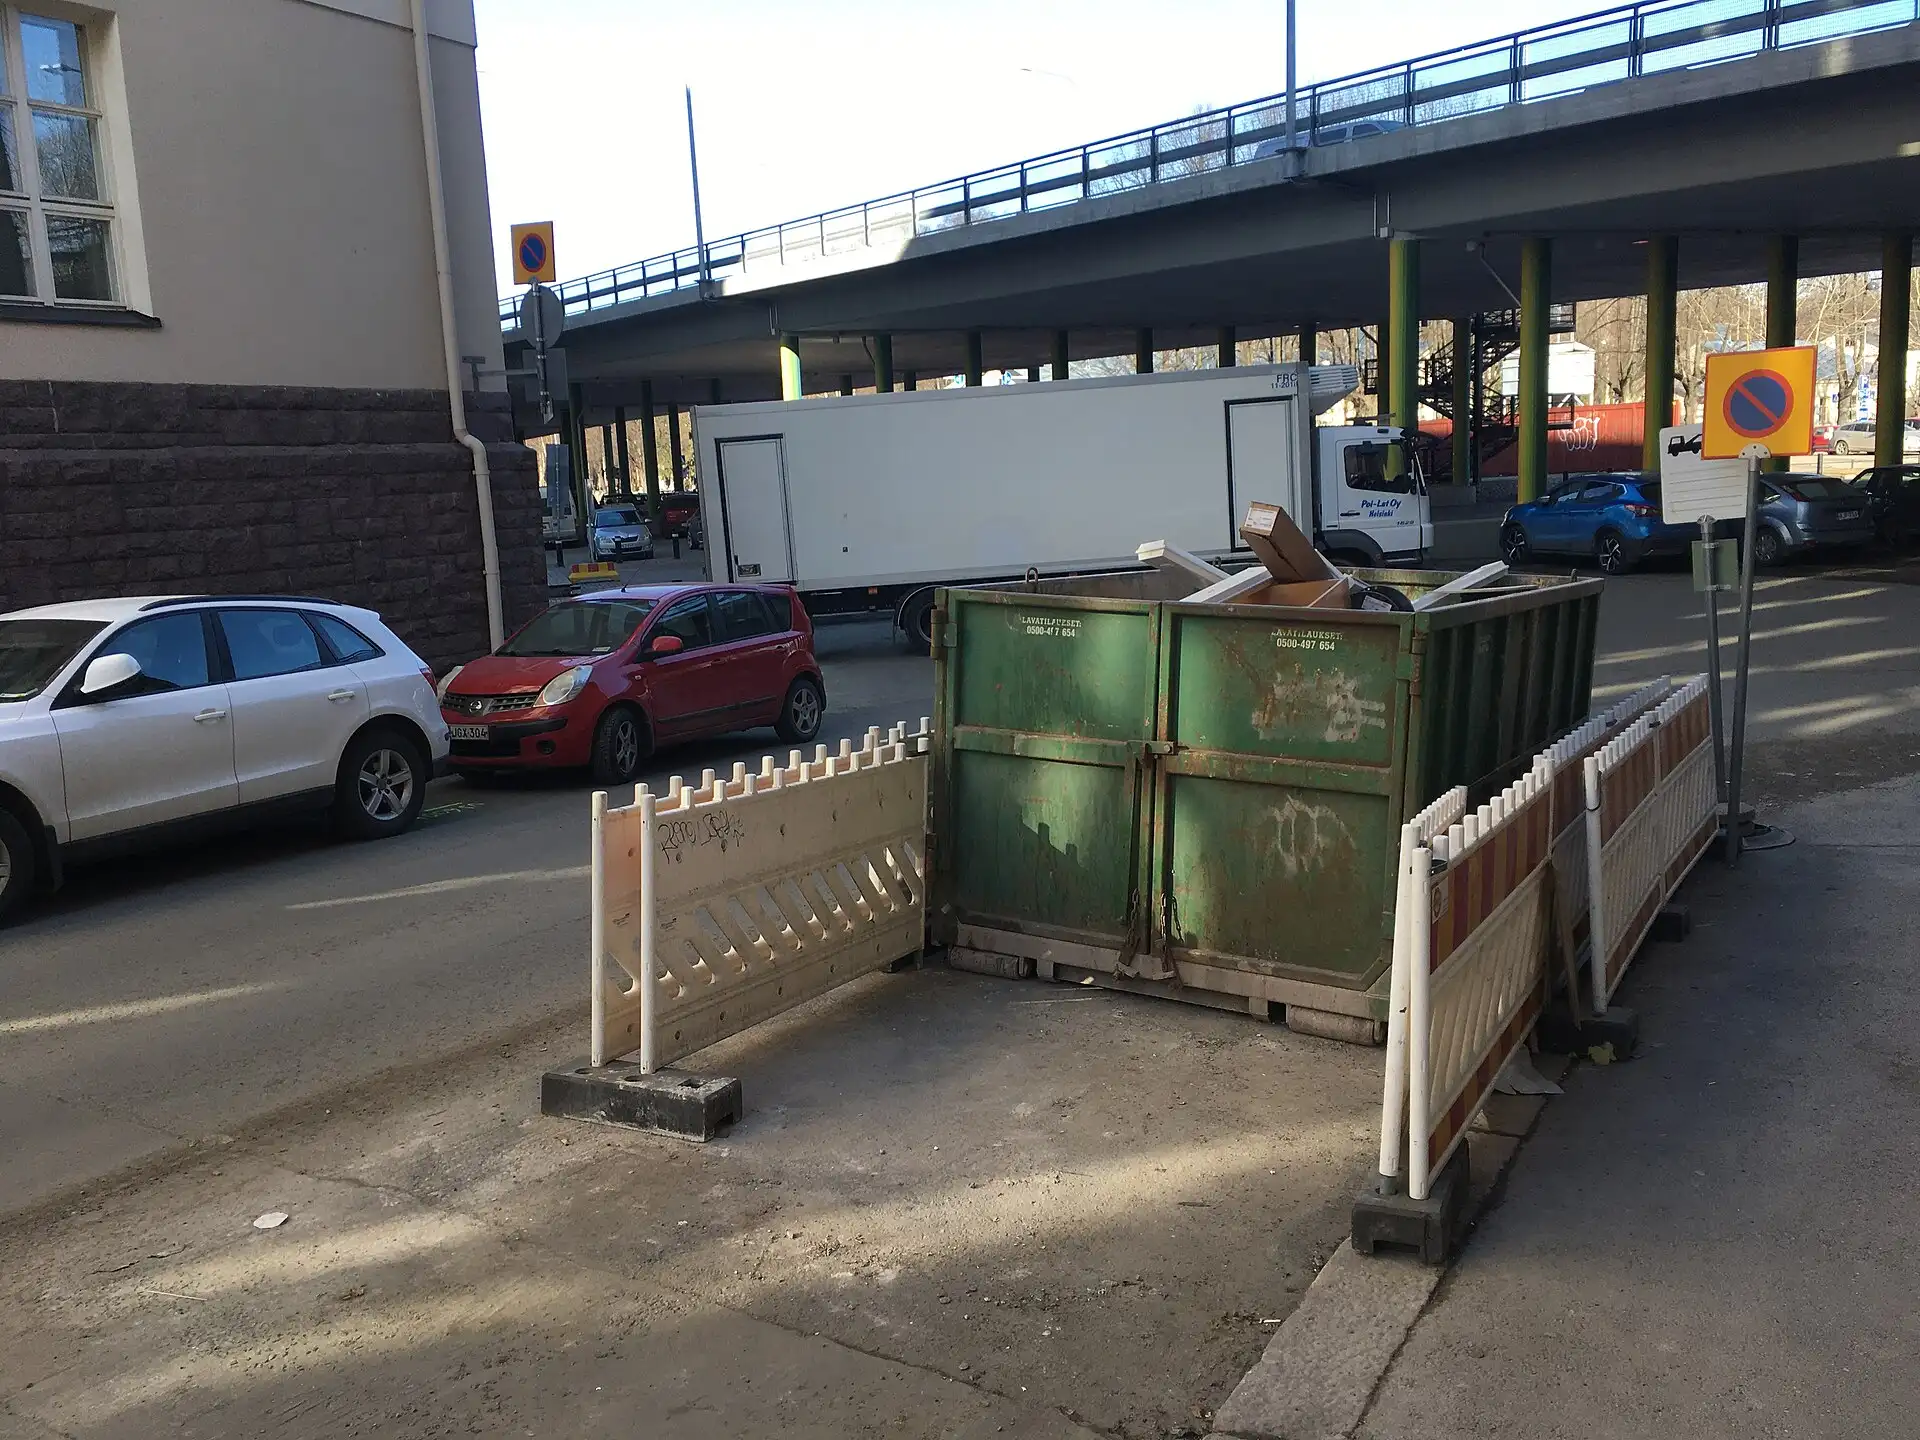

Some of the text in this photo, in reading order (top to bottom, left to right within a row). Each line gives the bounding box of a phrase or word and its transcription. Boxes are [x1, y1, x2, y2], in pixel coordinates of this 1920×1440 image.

[1277, 373, 1298, 383] FRC
[1390, 498, 1402, 509] Oy
[1061, 627, 1076, 637] 654
[1276, 638, 1335, 651] 0500-497 654
[452, 727, 486, 738] JGX-304
